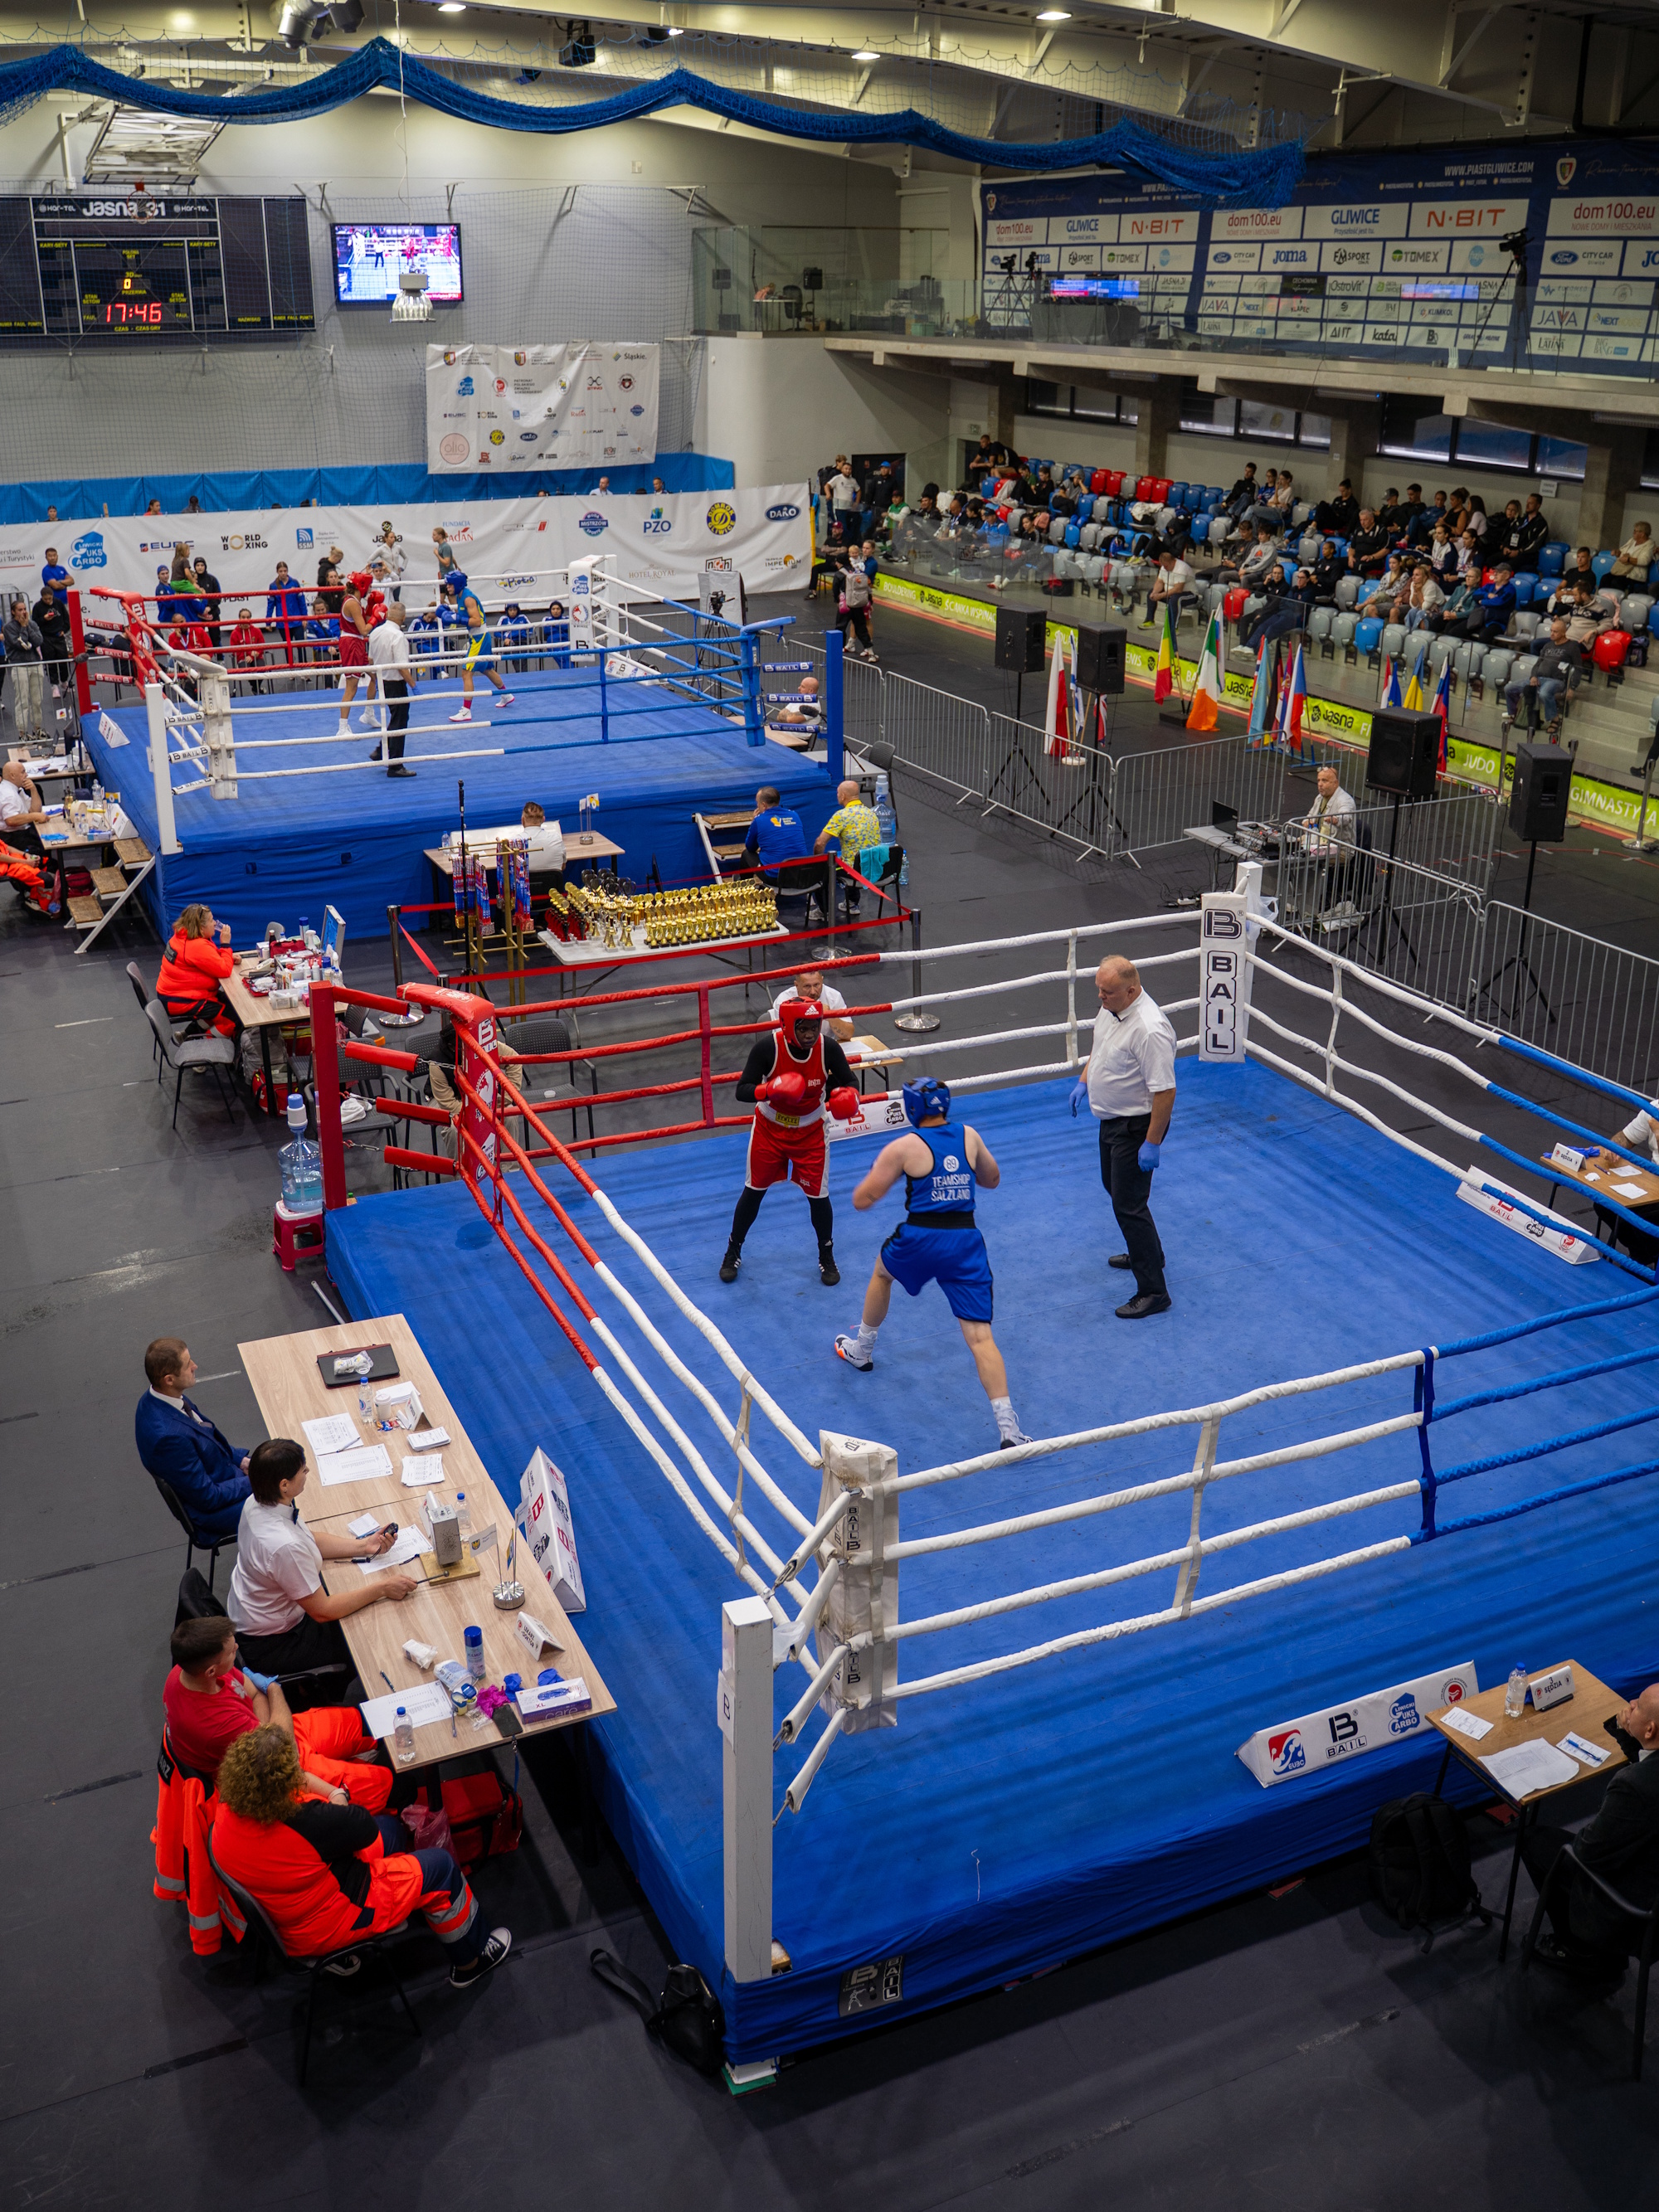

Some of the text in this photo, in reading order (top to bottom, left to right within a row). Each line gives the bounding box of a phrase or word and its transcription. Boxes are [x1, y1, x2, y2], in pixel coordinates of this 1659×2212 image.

[1444, 162, 1535, 177] WWW.PIASTGLIWICE.COM
[1331, 208, 1380, 226] GLIWICE
[1574, 202, 1656, 220] dom100.eu
[1067, 218, 1099, 233] GLIWICE
[1228, 212, 1282, 227] dom100.eu
[1571, 222, 1652, 231] NOWE DOMY MIESZKANIA
[996, 222, 1034, 235] dom100.eu
[1116, 254, 1140, 264] TOMEX
[1347, 252, 1370, 262] SPORT
[1402, 251, 1439, 263] TOMEX
[1331, 280, 1362, 292] OstroVit
[106, 303, 162, 323] 17:46
[1202, 299, 1229, 313] JAVA
[1537, 309, 1578, 327] JAVA
[624, 352, 647, 361] Śląskie.
[770, 507, 797, 518] DAKO
[644, 520, 672, 533] PZO
[7, 555, 35, 563] Turystyki
[86, 549, 103, 557] UKS
[69, 554, 102, 570] CARBO
[654, 570, 676, 579] ROYAL
[883, 581, 917, 600] BOULDERING
[944, 599, 970, 615] ŚCANKA
[1126, 652, 1142, 667] ENIS
[1323, 709, 1355, 729] Jasna
[1462, 754, 1657, 826] JUDO GIMNASTYA
[1209, 955, 1233, 1050] BAIL
[845, 1124, 870, 1134] BAIL
[1561, 1154, 1573, 1163] SĘDZIA
[932, 1174, 971, 1189] TEAMSHOP
[931, 1189, 971, 1202] SALZLAND
[1490, 1205, 1512, 1222] BAIL
[1525, 1222, 1544, 1237] CARBO
[849, 1507, 858, 1539] BAIL
[847, 1541, 861, 1551] B
[523, 1625, 535, 1641] LEKARZ
[848, 1674, 861, 1685] B
[1549, 1676, 1554, 1685] 3
[1545, 1681, 1563, 1694] SĘDZIA
[723, 1692, 731, 1720] B
[1402, 1709, 1415, 1719] UKS
[1328, 1712, 1359, 1743] B
[1389, 1717, 1418, 1736] CARBO
[1327, 1736, 1366, 1757] BAIL
[1288, 1758, 1305, 1770] EUBC
[850, 1965, 878, 1986] B
[886, 1957, 900, 1999] BAIL
